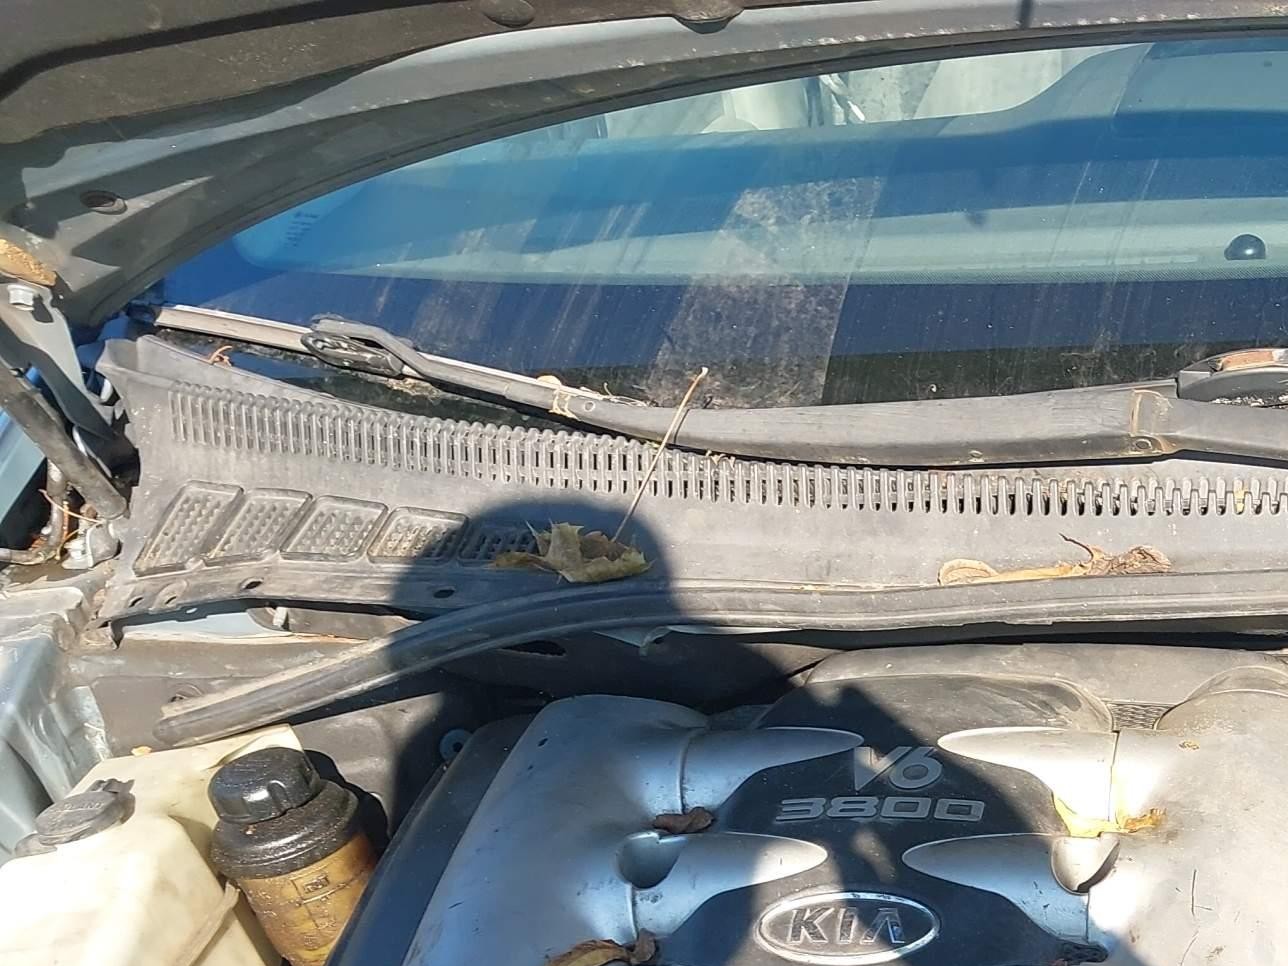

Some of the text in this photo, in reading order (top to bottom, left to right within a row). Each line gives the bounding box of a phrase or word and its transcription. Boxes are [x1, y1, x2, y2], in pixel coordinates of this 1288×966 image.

[853, 746, 943, 791] V6
[776, 796, 985, 822] 3800
[788, 906, 905, 944] KIA
